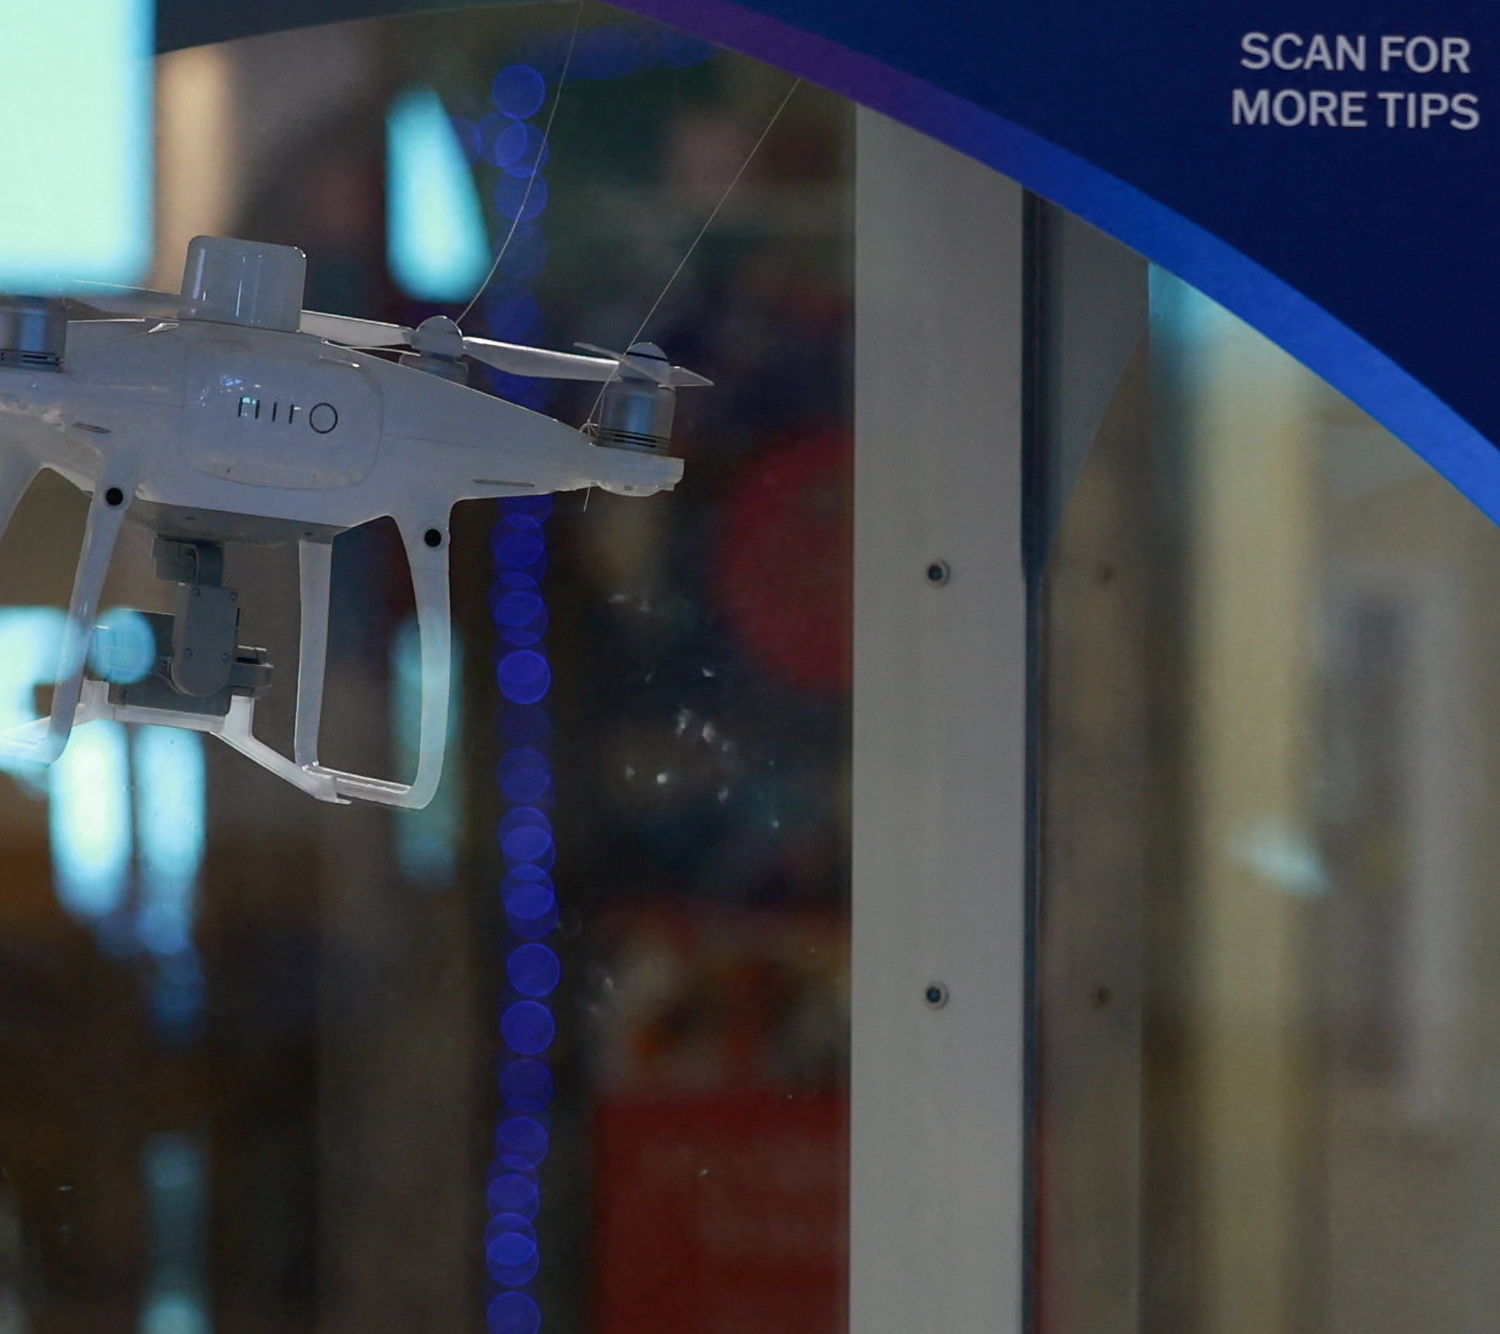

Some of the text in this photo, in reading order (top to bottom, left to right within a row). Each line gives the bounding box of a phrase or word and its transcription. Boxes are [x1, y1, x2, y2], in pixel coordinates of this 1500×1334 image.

[1240, 31, 1471, 74] SCAN FOR
[1232, 88, 1480, 131] MORE TIPS
